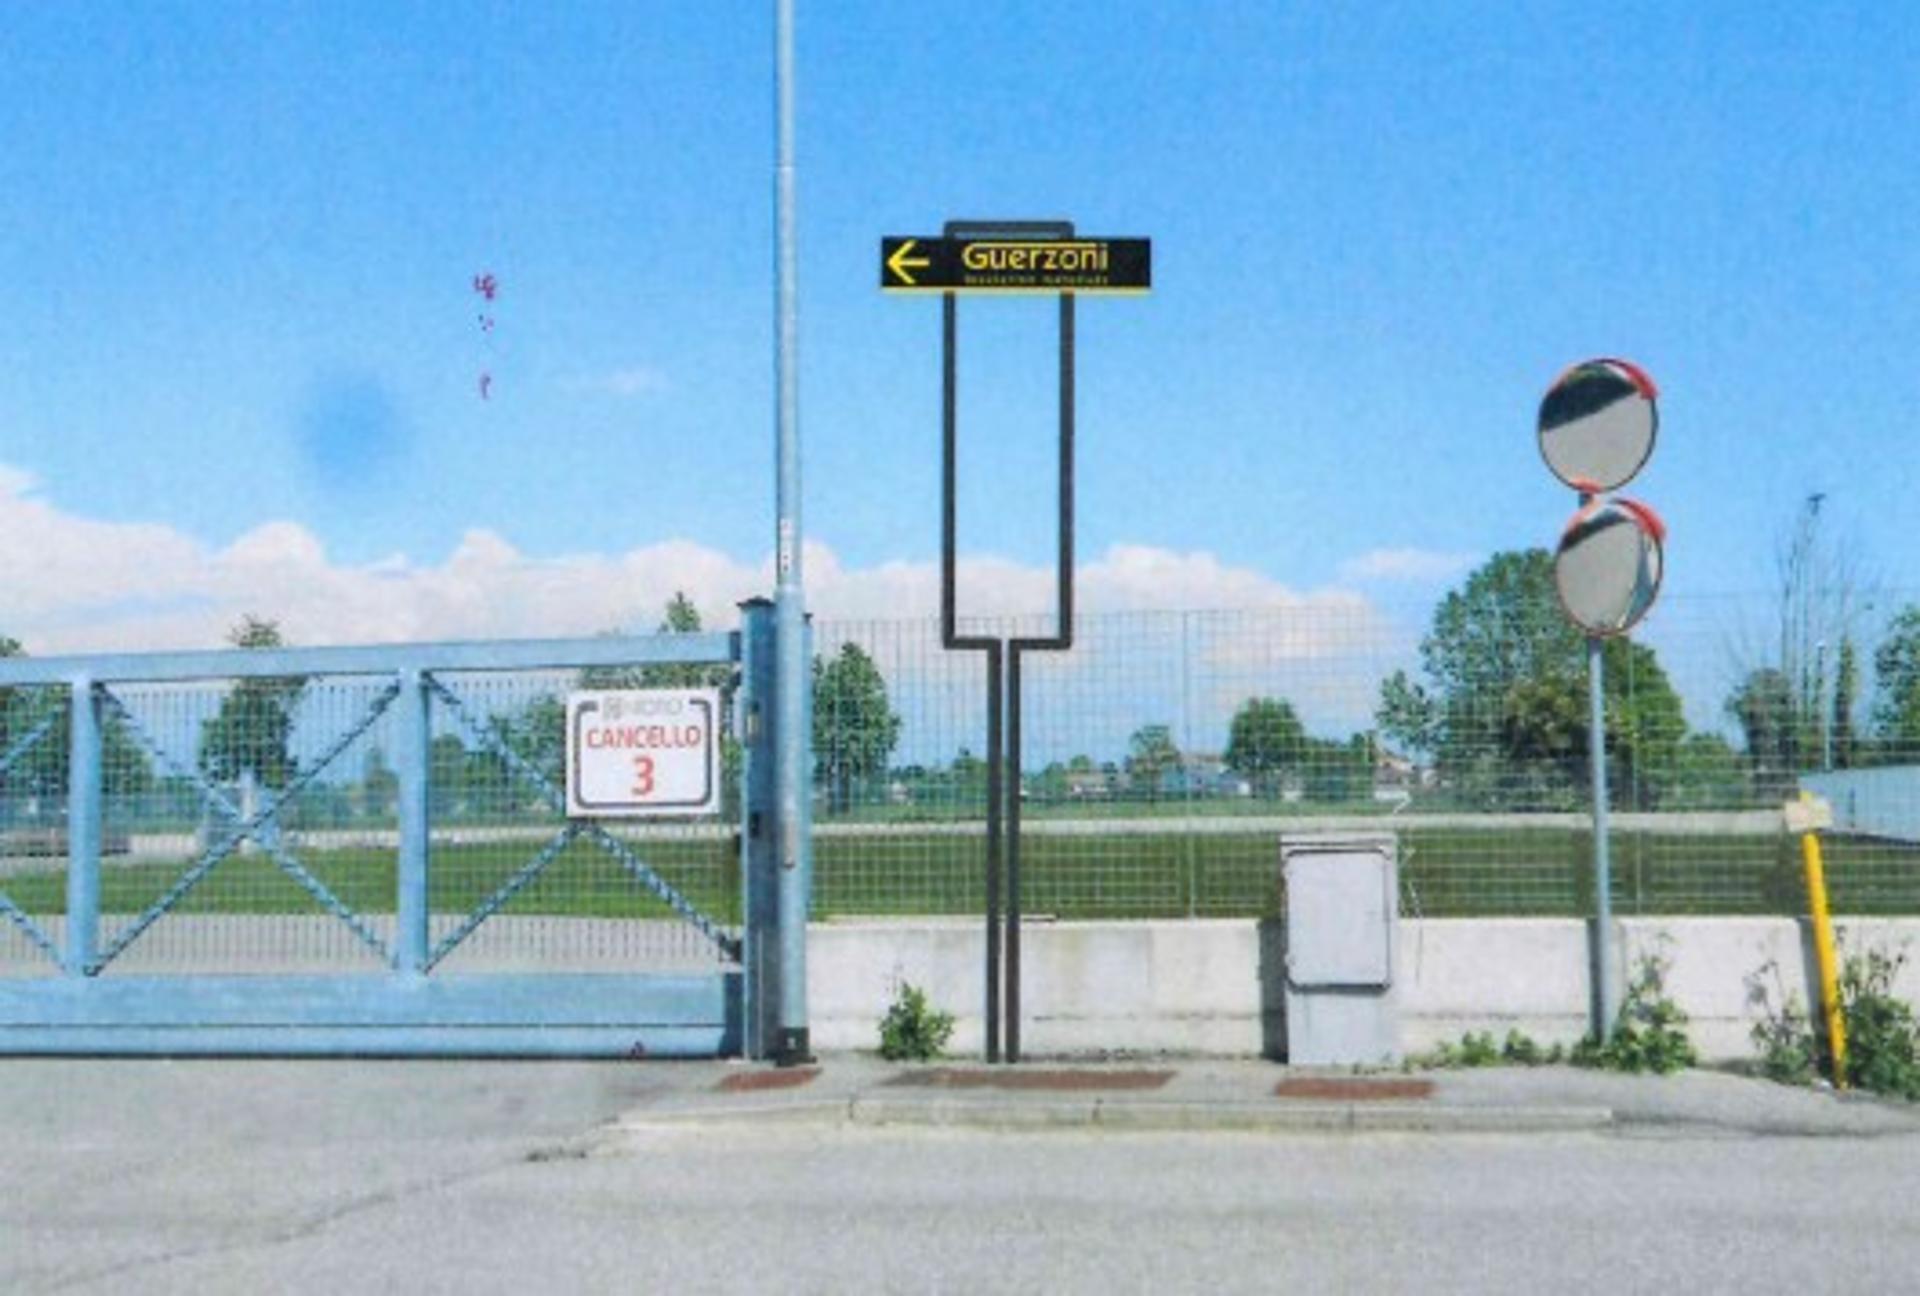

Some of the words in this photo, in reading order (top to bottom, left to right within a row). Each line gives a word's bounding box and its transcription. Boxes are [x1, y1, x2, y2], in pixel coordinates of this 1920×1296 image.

[962, 242, 1108, 270] Guerzoni
[587, 725, 701, 748] CANCELLO
[632, 755, 655, 796] 3
